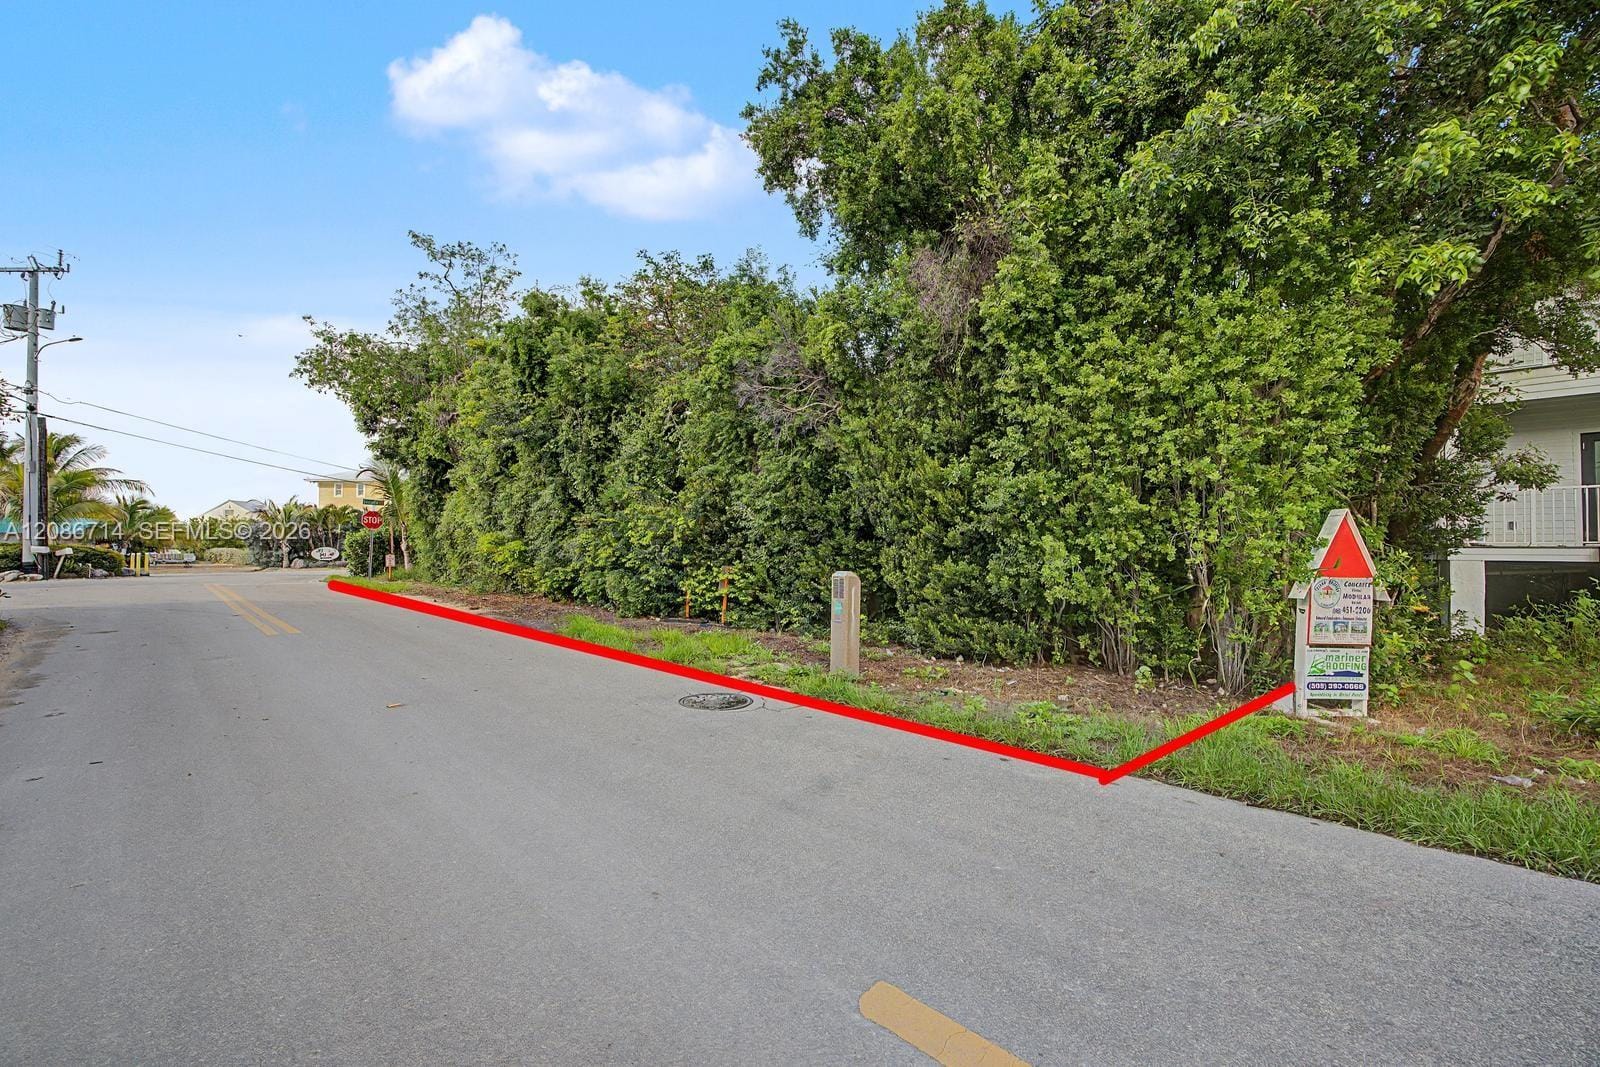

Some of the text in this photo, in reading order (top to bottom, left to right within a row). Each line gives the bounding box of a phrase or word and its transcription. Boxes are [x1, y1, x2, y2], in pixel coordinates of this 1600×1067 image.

[363, 516, 383, 524] STOP
[1326, 652, 1366, 662] mariner
[1326, 662, 1366, 671] ROOFING
